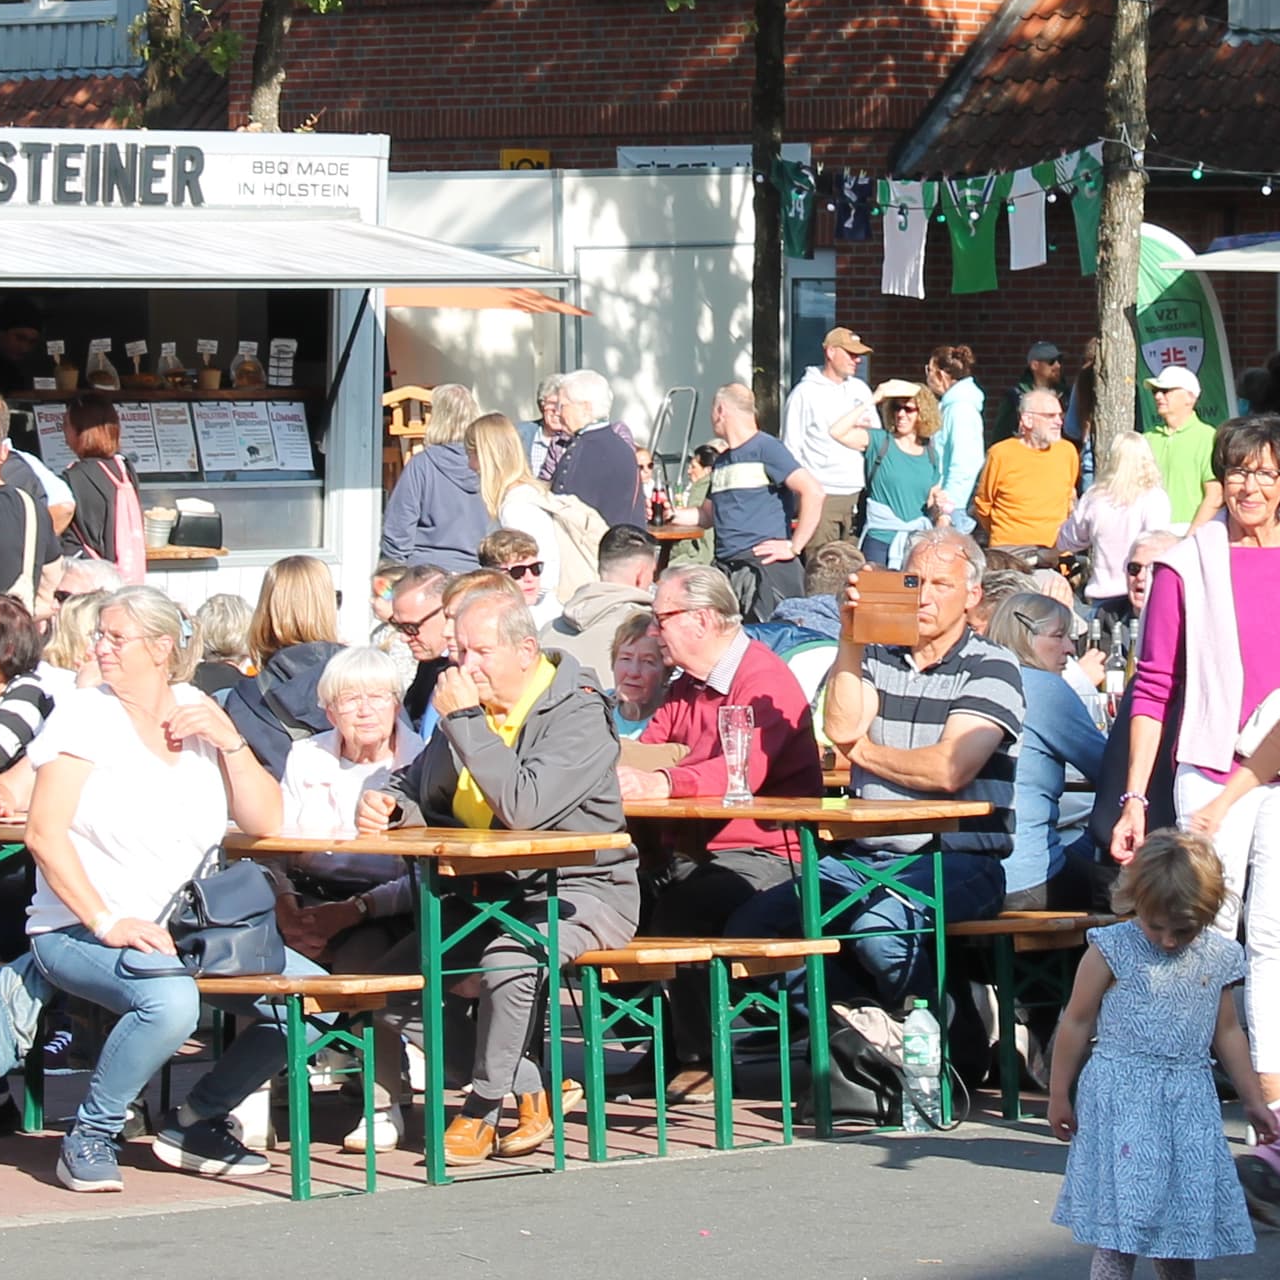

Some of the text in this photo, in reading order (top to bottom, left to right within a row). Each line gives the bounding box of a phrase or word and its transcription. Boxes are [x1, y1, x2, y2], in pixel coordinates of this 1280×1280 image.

[252, 160, 350, 176] BBQ MADE
[238, 182, 350, 198] IN HOLSTEIN
